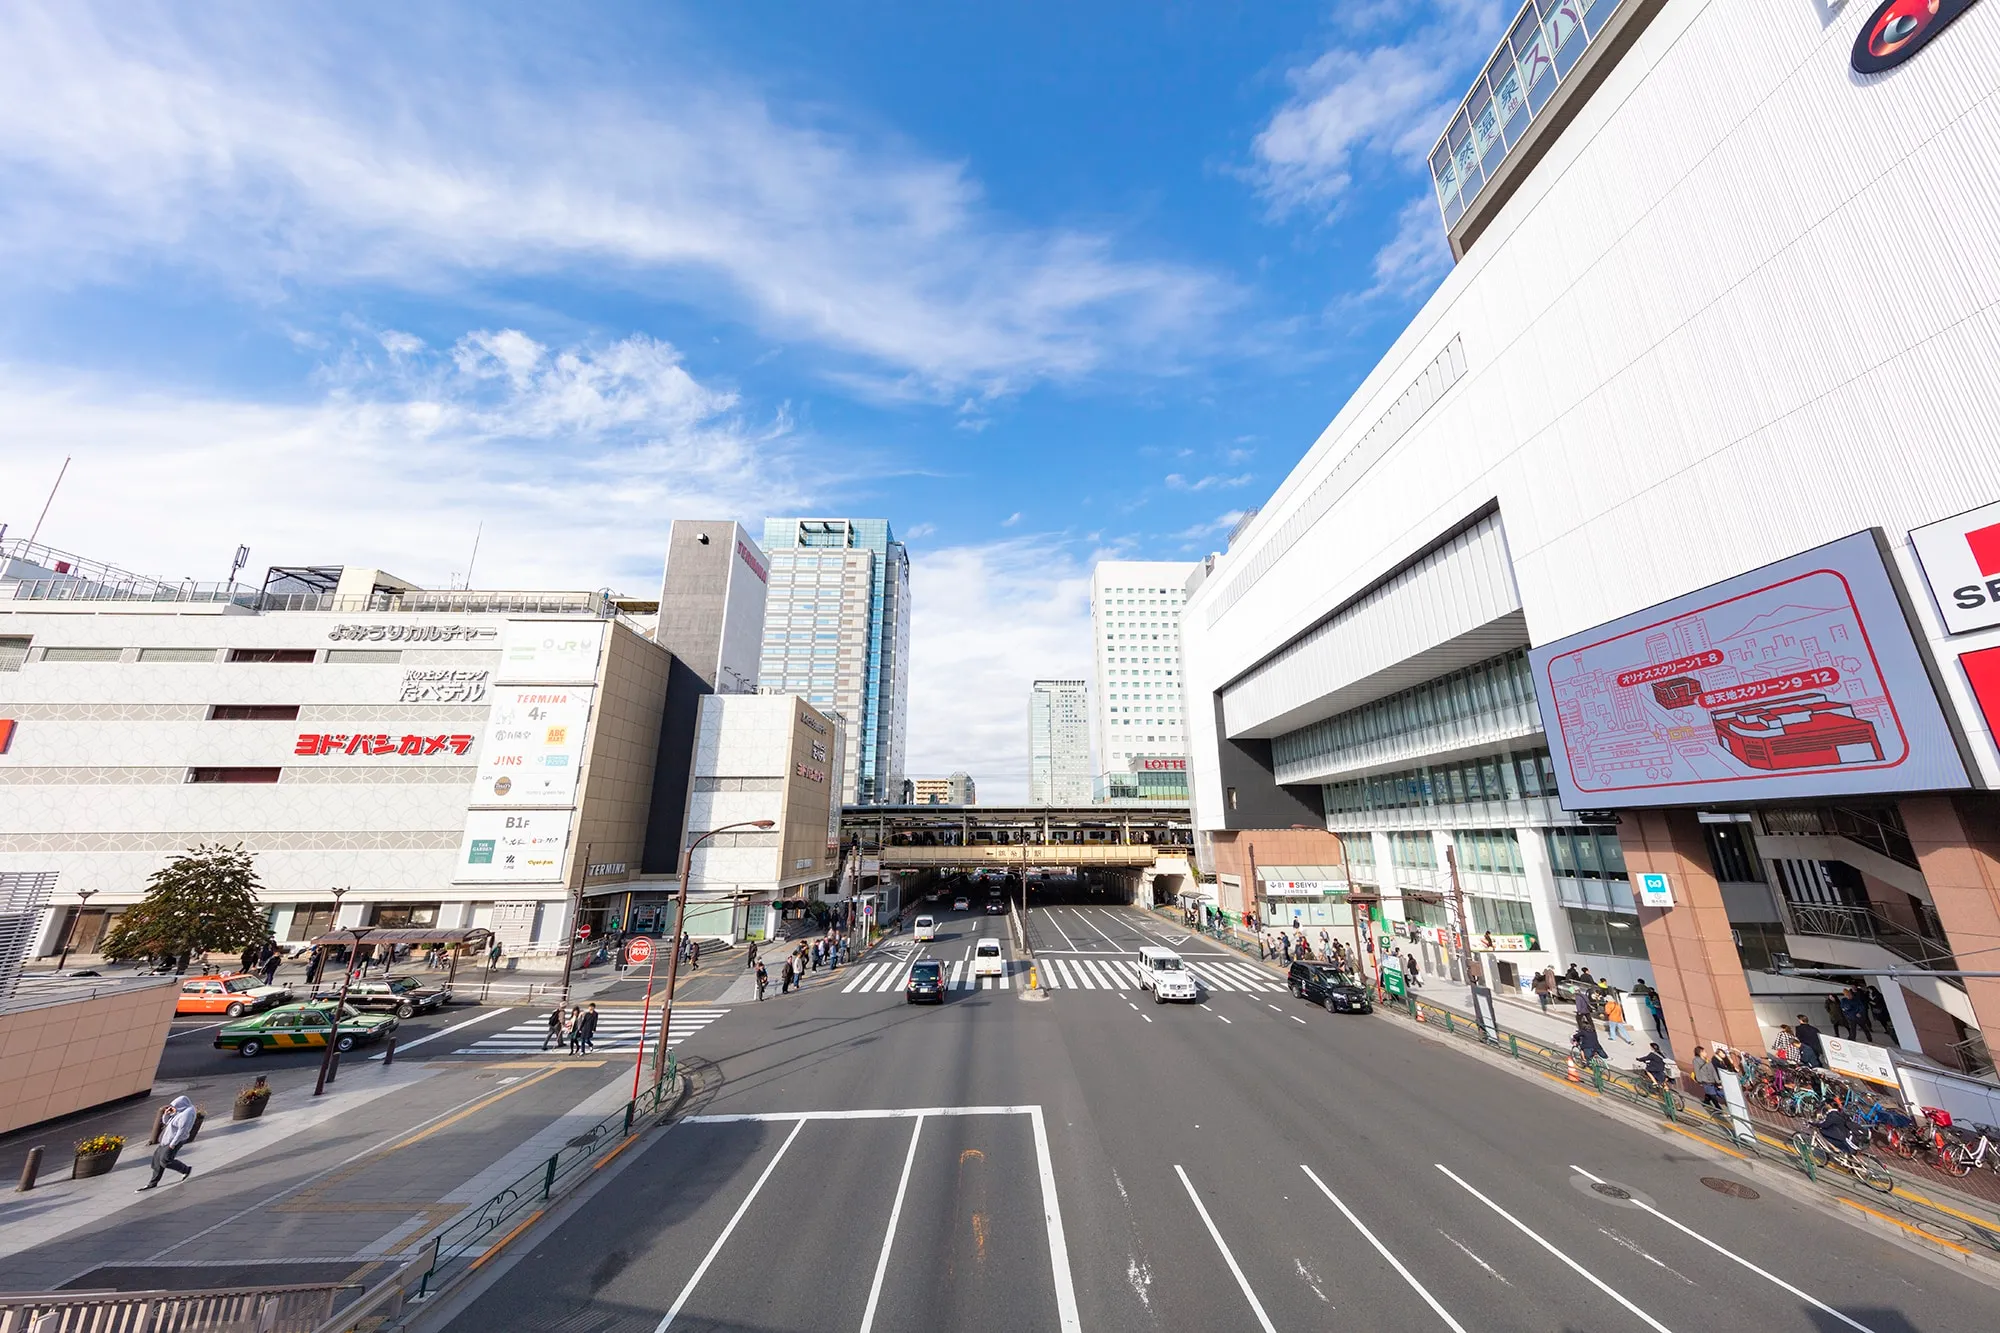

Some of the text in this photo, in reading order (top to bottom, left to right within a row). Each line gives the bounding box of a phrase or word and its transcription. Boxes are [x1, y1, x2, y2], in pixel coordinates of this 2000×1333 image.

[1440, 78, 1519, 196] 天然温泉
[328, 624, 498, 642] よみうりカルチャー
[517, 694, 567, 704] TERMINA
[528, 706, 548, 721] 4F
[548, 729, 565, 737] ABC
[294, 734, 475, 756] ヨドバシカメラ
[493, 756, 523, 766] J!NS
[505, 816, 530, 829] B1F
[589, 863, 626, 876] TERMINA
